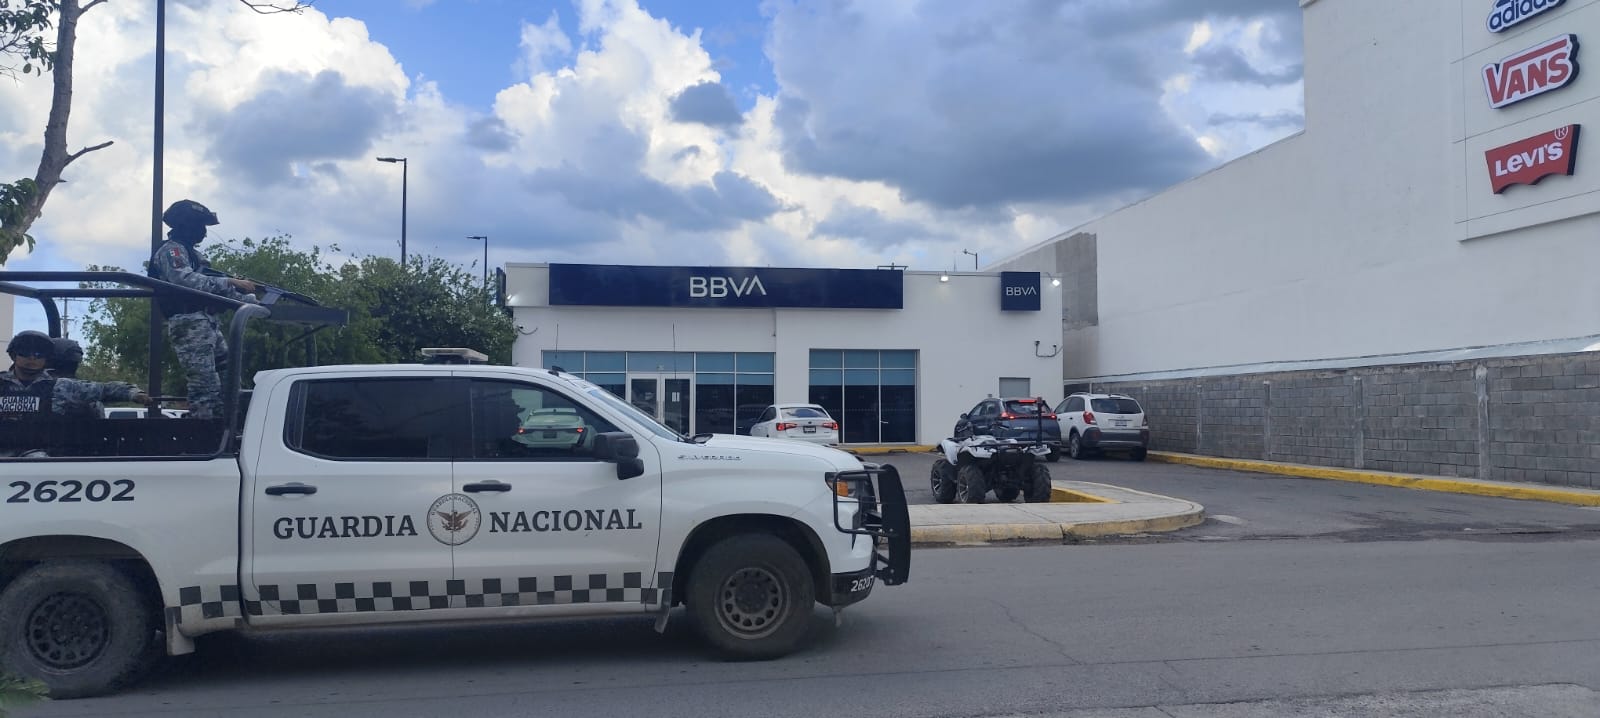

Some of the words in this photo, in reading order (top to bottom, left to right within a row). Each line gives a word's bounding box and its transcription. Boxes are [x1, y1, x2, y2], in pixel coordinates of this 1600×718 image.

[1485, 38, 1569, 104] VANS
[689, 275, 767, 298] BBVA
[1006, 286, 1037, 298] BBVA
[2, 397, 36, 405] GUARDIA
[6, 479, 136, 504] 26202
[272, 514, 419, 540] GUARDIA
[490, 508, 643, 534] NACIONAL
